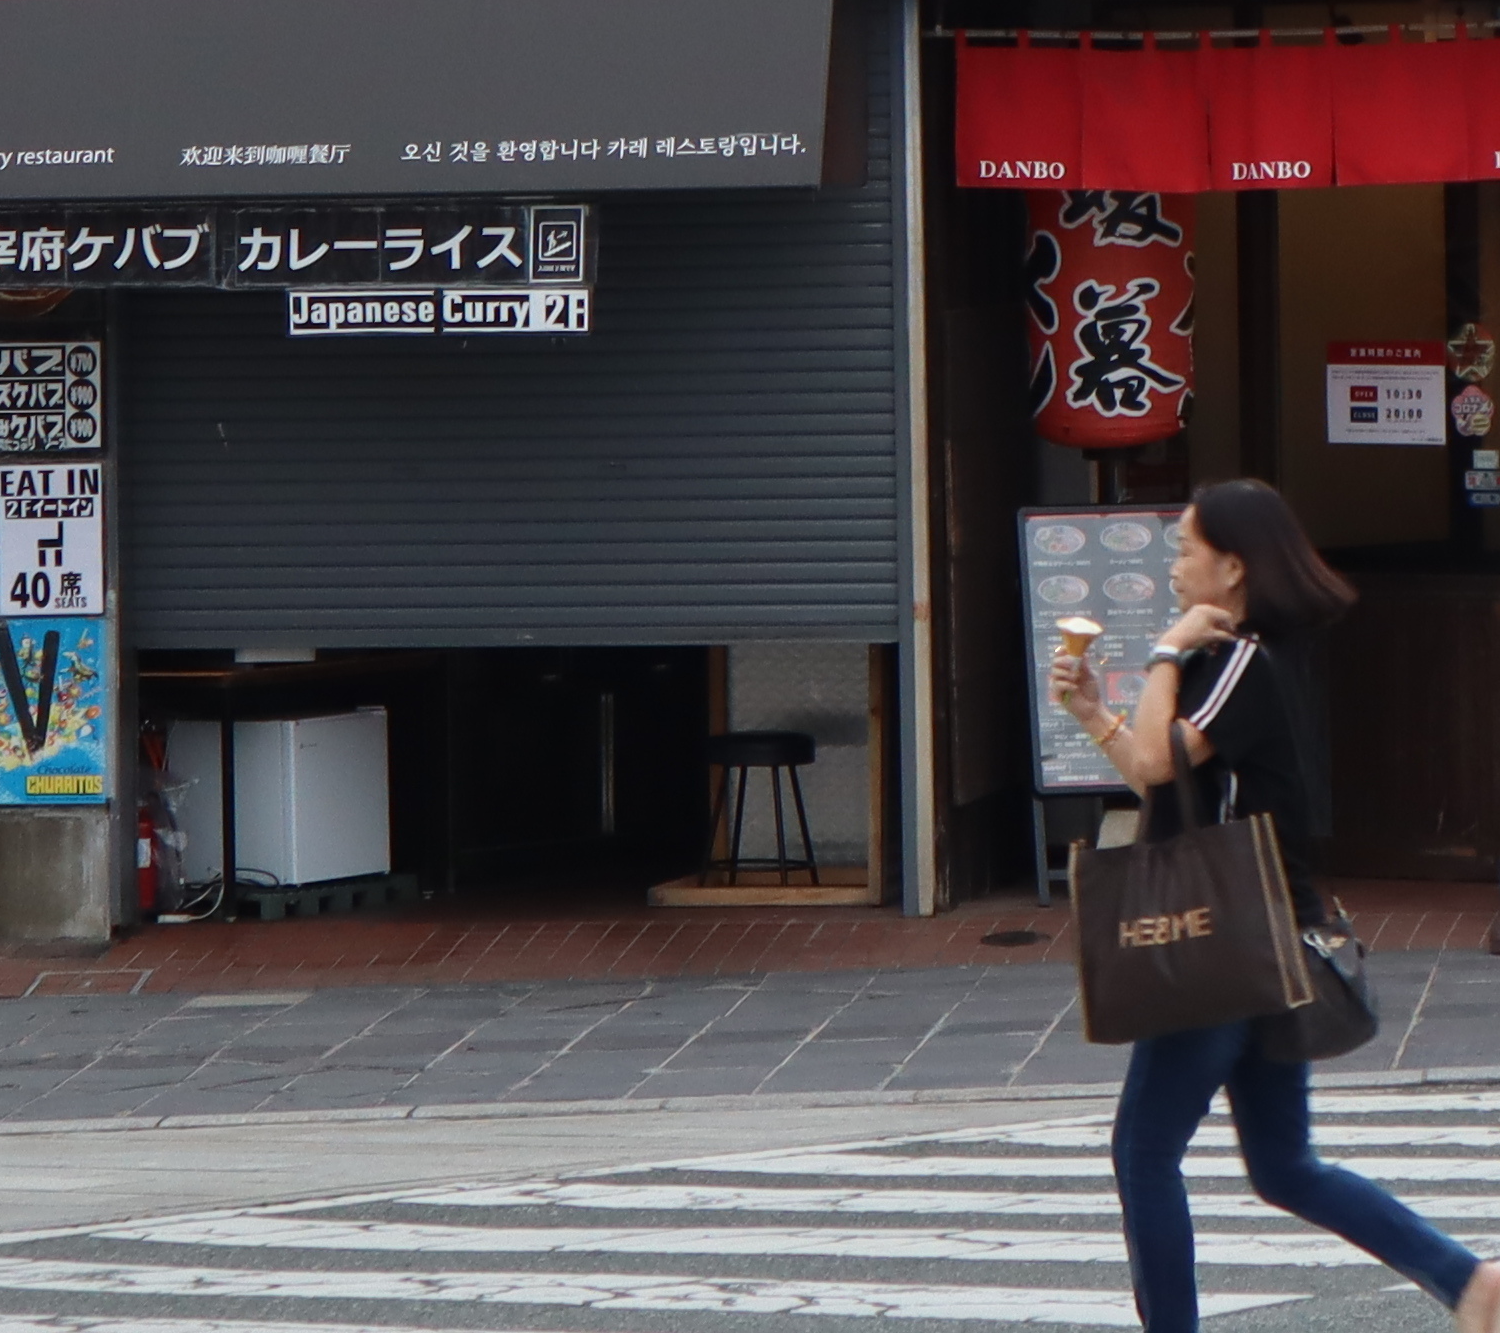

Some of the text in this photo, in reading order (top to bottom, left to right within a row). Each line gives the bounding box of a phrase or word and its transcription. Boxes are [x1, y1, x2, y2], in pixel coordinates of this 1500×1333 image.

[16, 146, 115, 166] restaurant
[180, 143, 351, 166] 欢迎来到咖喱餐厅
[400, 141, 441, 162] 오신
[449, 139, 492, 163] 것을
[497, 137, 602, 162] 환영합니다
[606, 136, 649, 160] 카레
[978, 159, 1066, 181] DANBO
[1232, 159, 1312, 182] DANBO
[236, 225, 524, 273] カレーライス
[291, 295, 435, 330] Japanese
[442, 294, 530, 329] Curry
[1385, 388, 1423, 400] 10:30
[0, 468, 99, 497] EAT IN
[10, 571, 50, 608] 40
[60, 572, 82, 597] 席
[54, 597, 88, 609] SEATS
